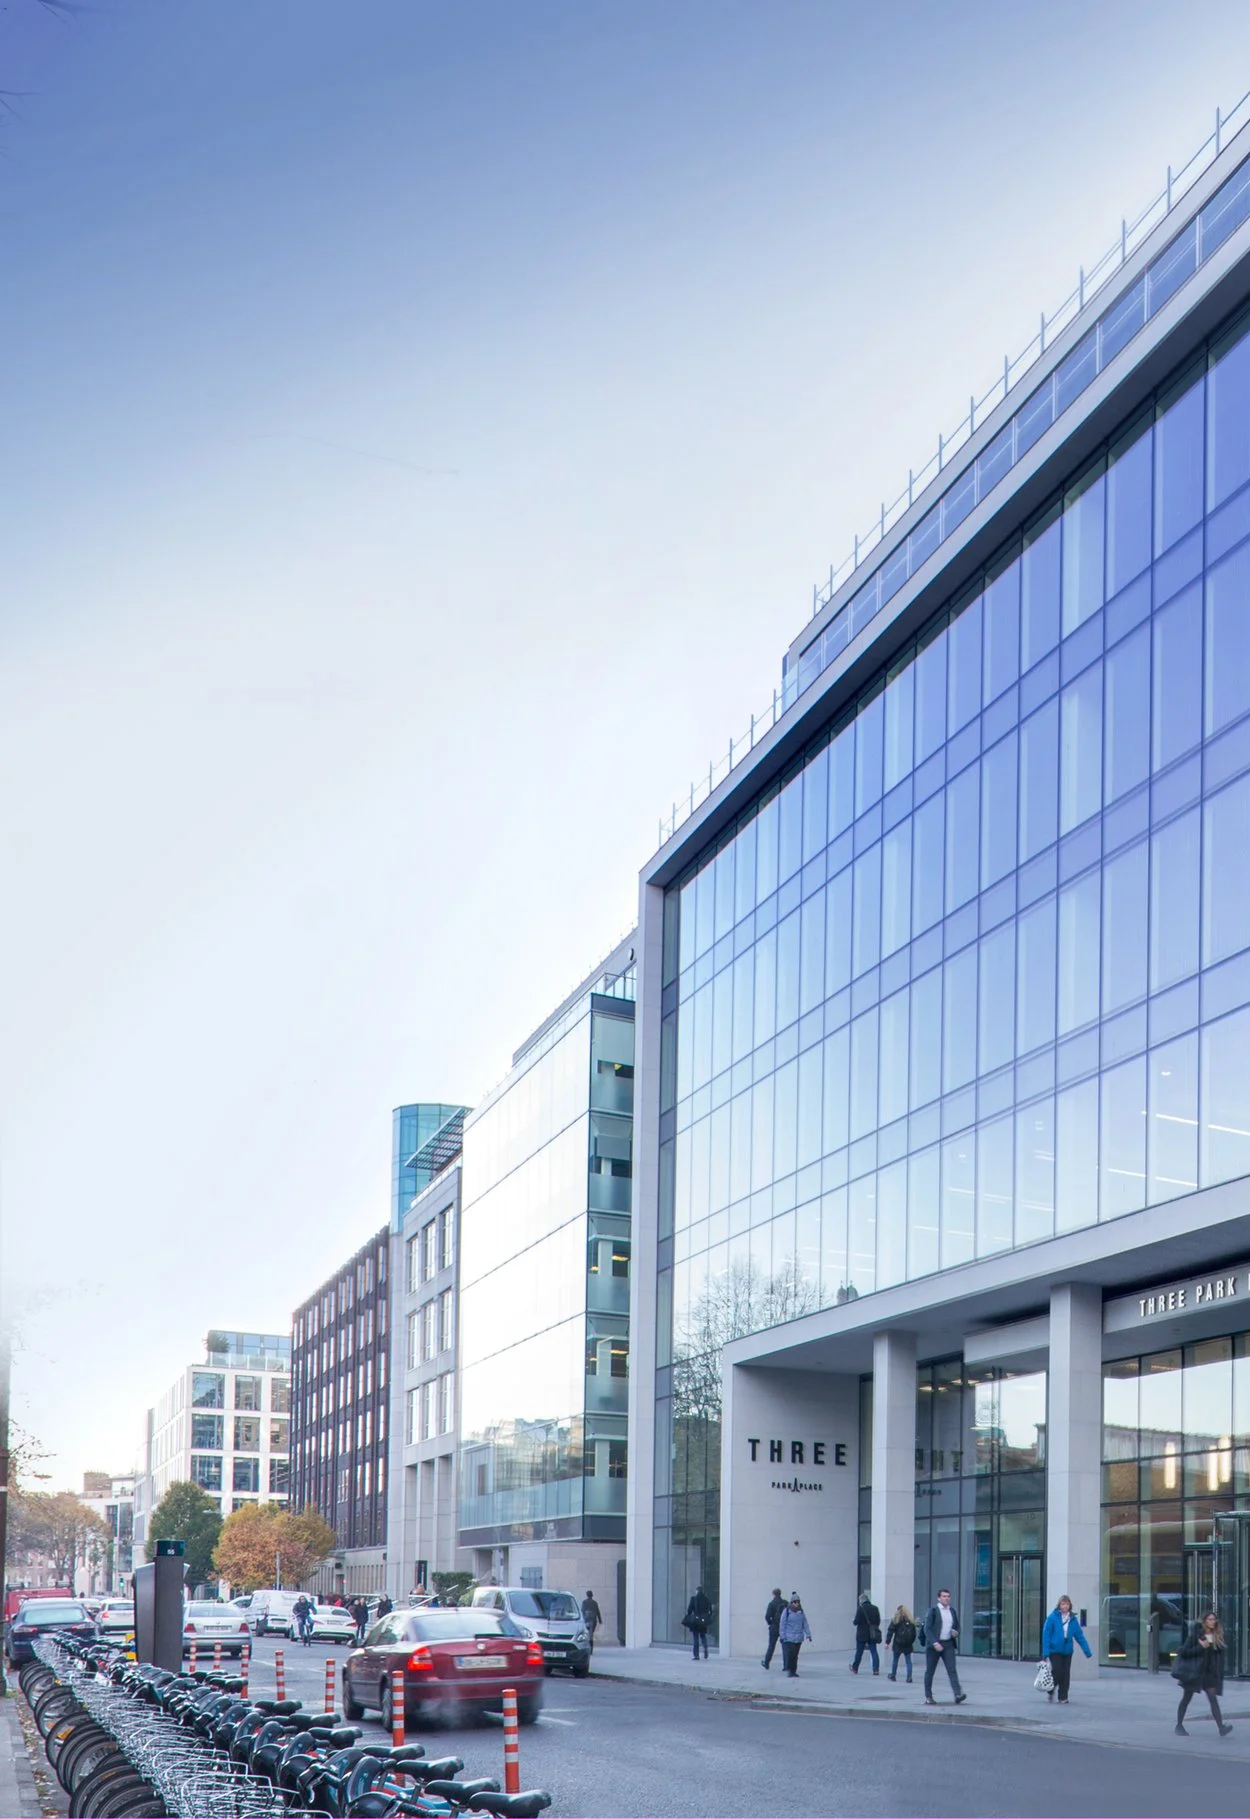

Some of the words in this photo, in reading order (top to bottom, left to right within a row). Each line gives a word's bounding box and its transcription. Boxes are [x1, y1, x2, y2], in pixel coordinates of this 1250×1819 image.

[1139, 1290, 1186, 1316] THREE
[1196, 1277, 1236, 1303] PARK
[748, 1439, 847, 1466] THREE
[771, 1481, 791, 1490] PARK
[799, 1483, 823, 1491] PLACE
